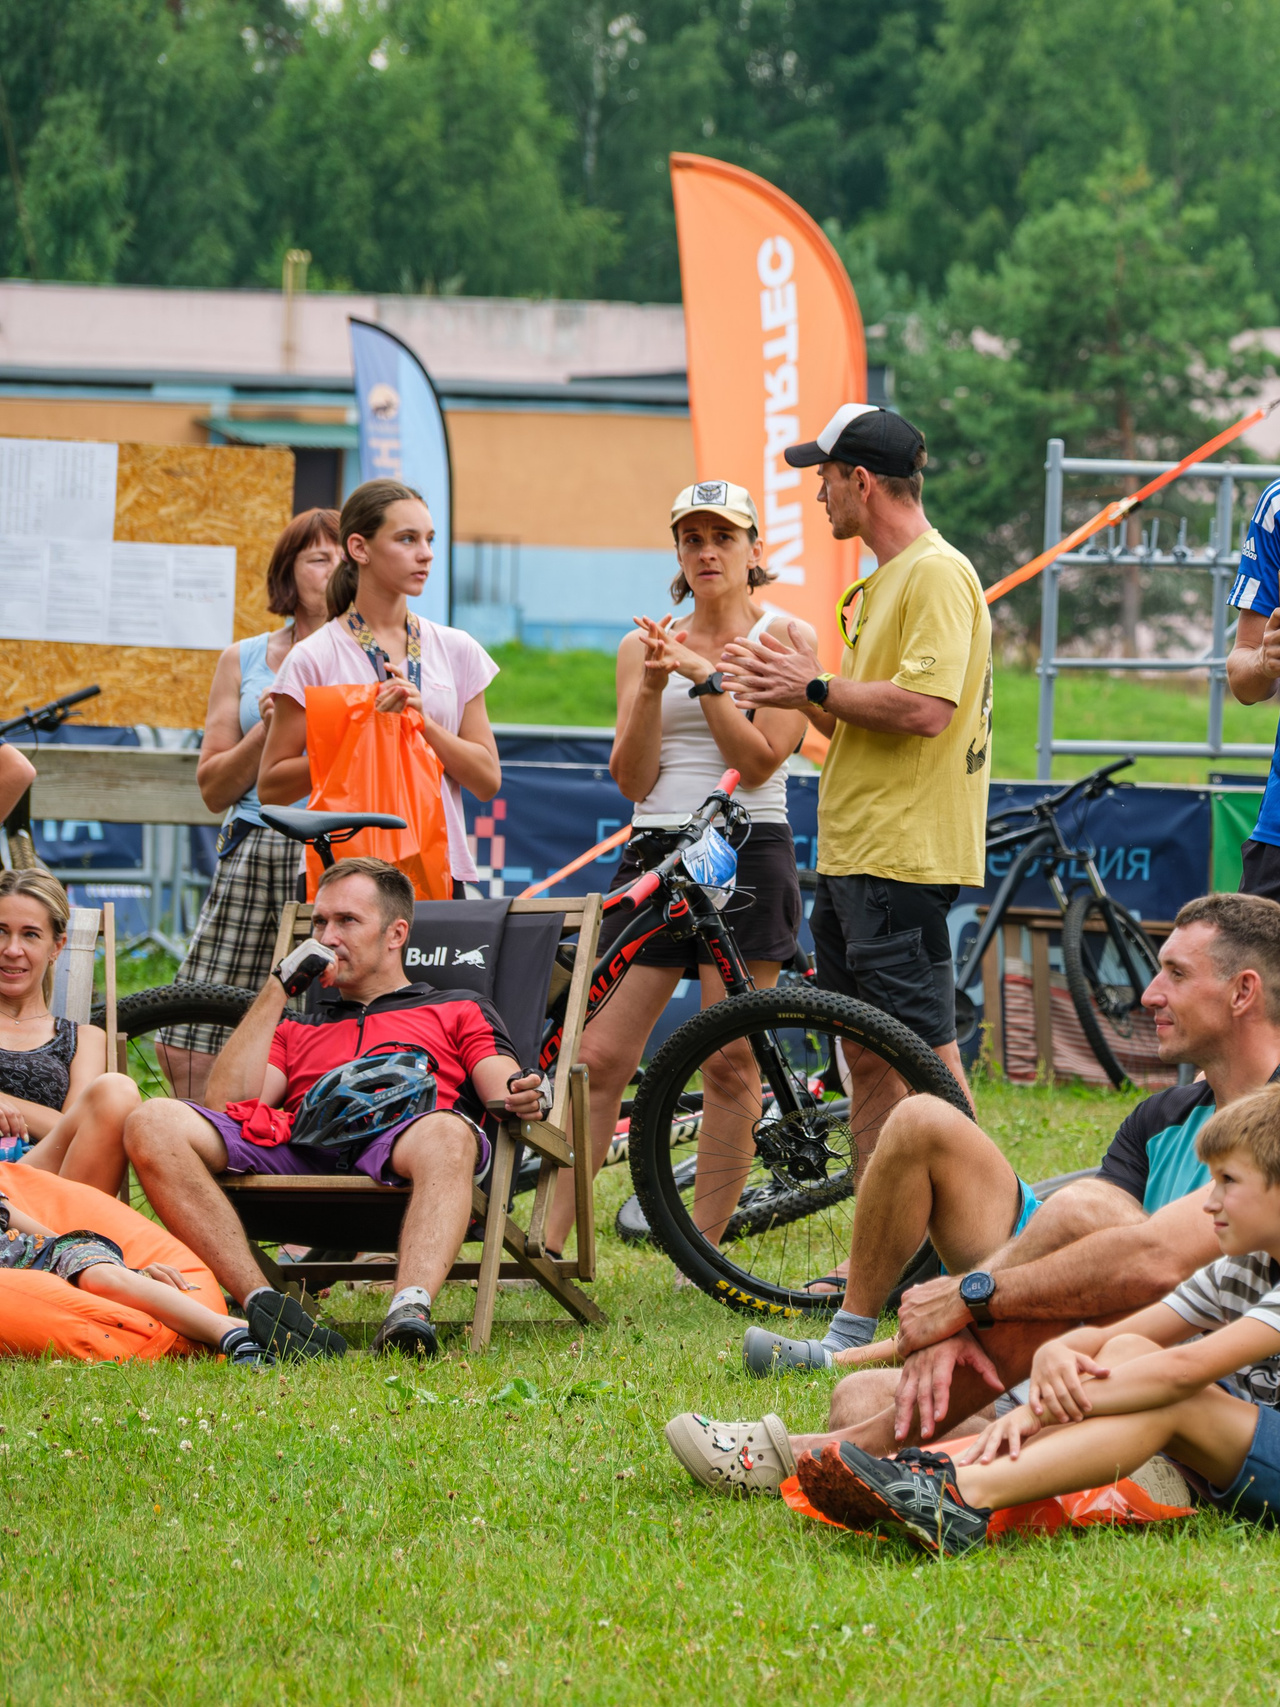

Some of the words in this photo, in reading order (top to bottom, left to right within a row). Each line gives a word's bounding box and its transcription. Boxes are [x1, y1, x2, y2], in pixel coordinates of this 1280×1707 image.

[405, 947, 447, 966] Bull
[709, 938, 734, 982] Lefty
[715, 1279, 803, 1318] MAXXIS
